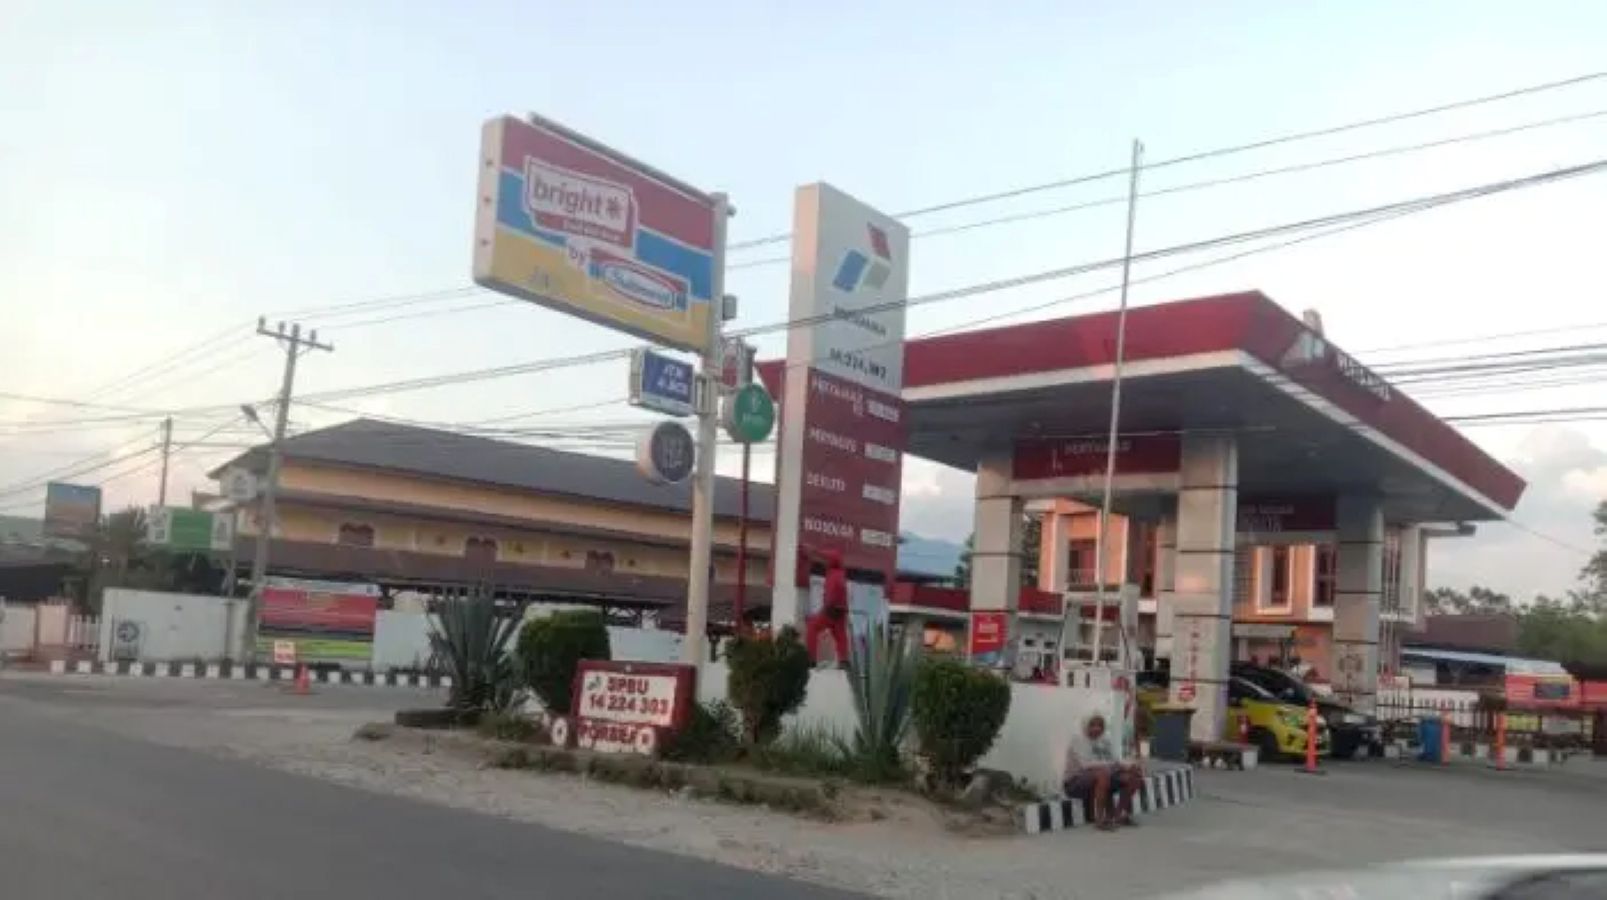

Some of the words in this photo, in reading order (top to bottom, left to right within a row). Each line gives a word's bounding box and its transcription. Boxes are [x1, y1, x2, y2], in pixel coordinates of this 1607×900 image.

[532, 172, 602, 216] bright
[569, 246, 588, 267] by
[607, 676, 649, 694] SPBU
[590, 694, 604, 708] 14
[607, 694, 636, 712] 224
